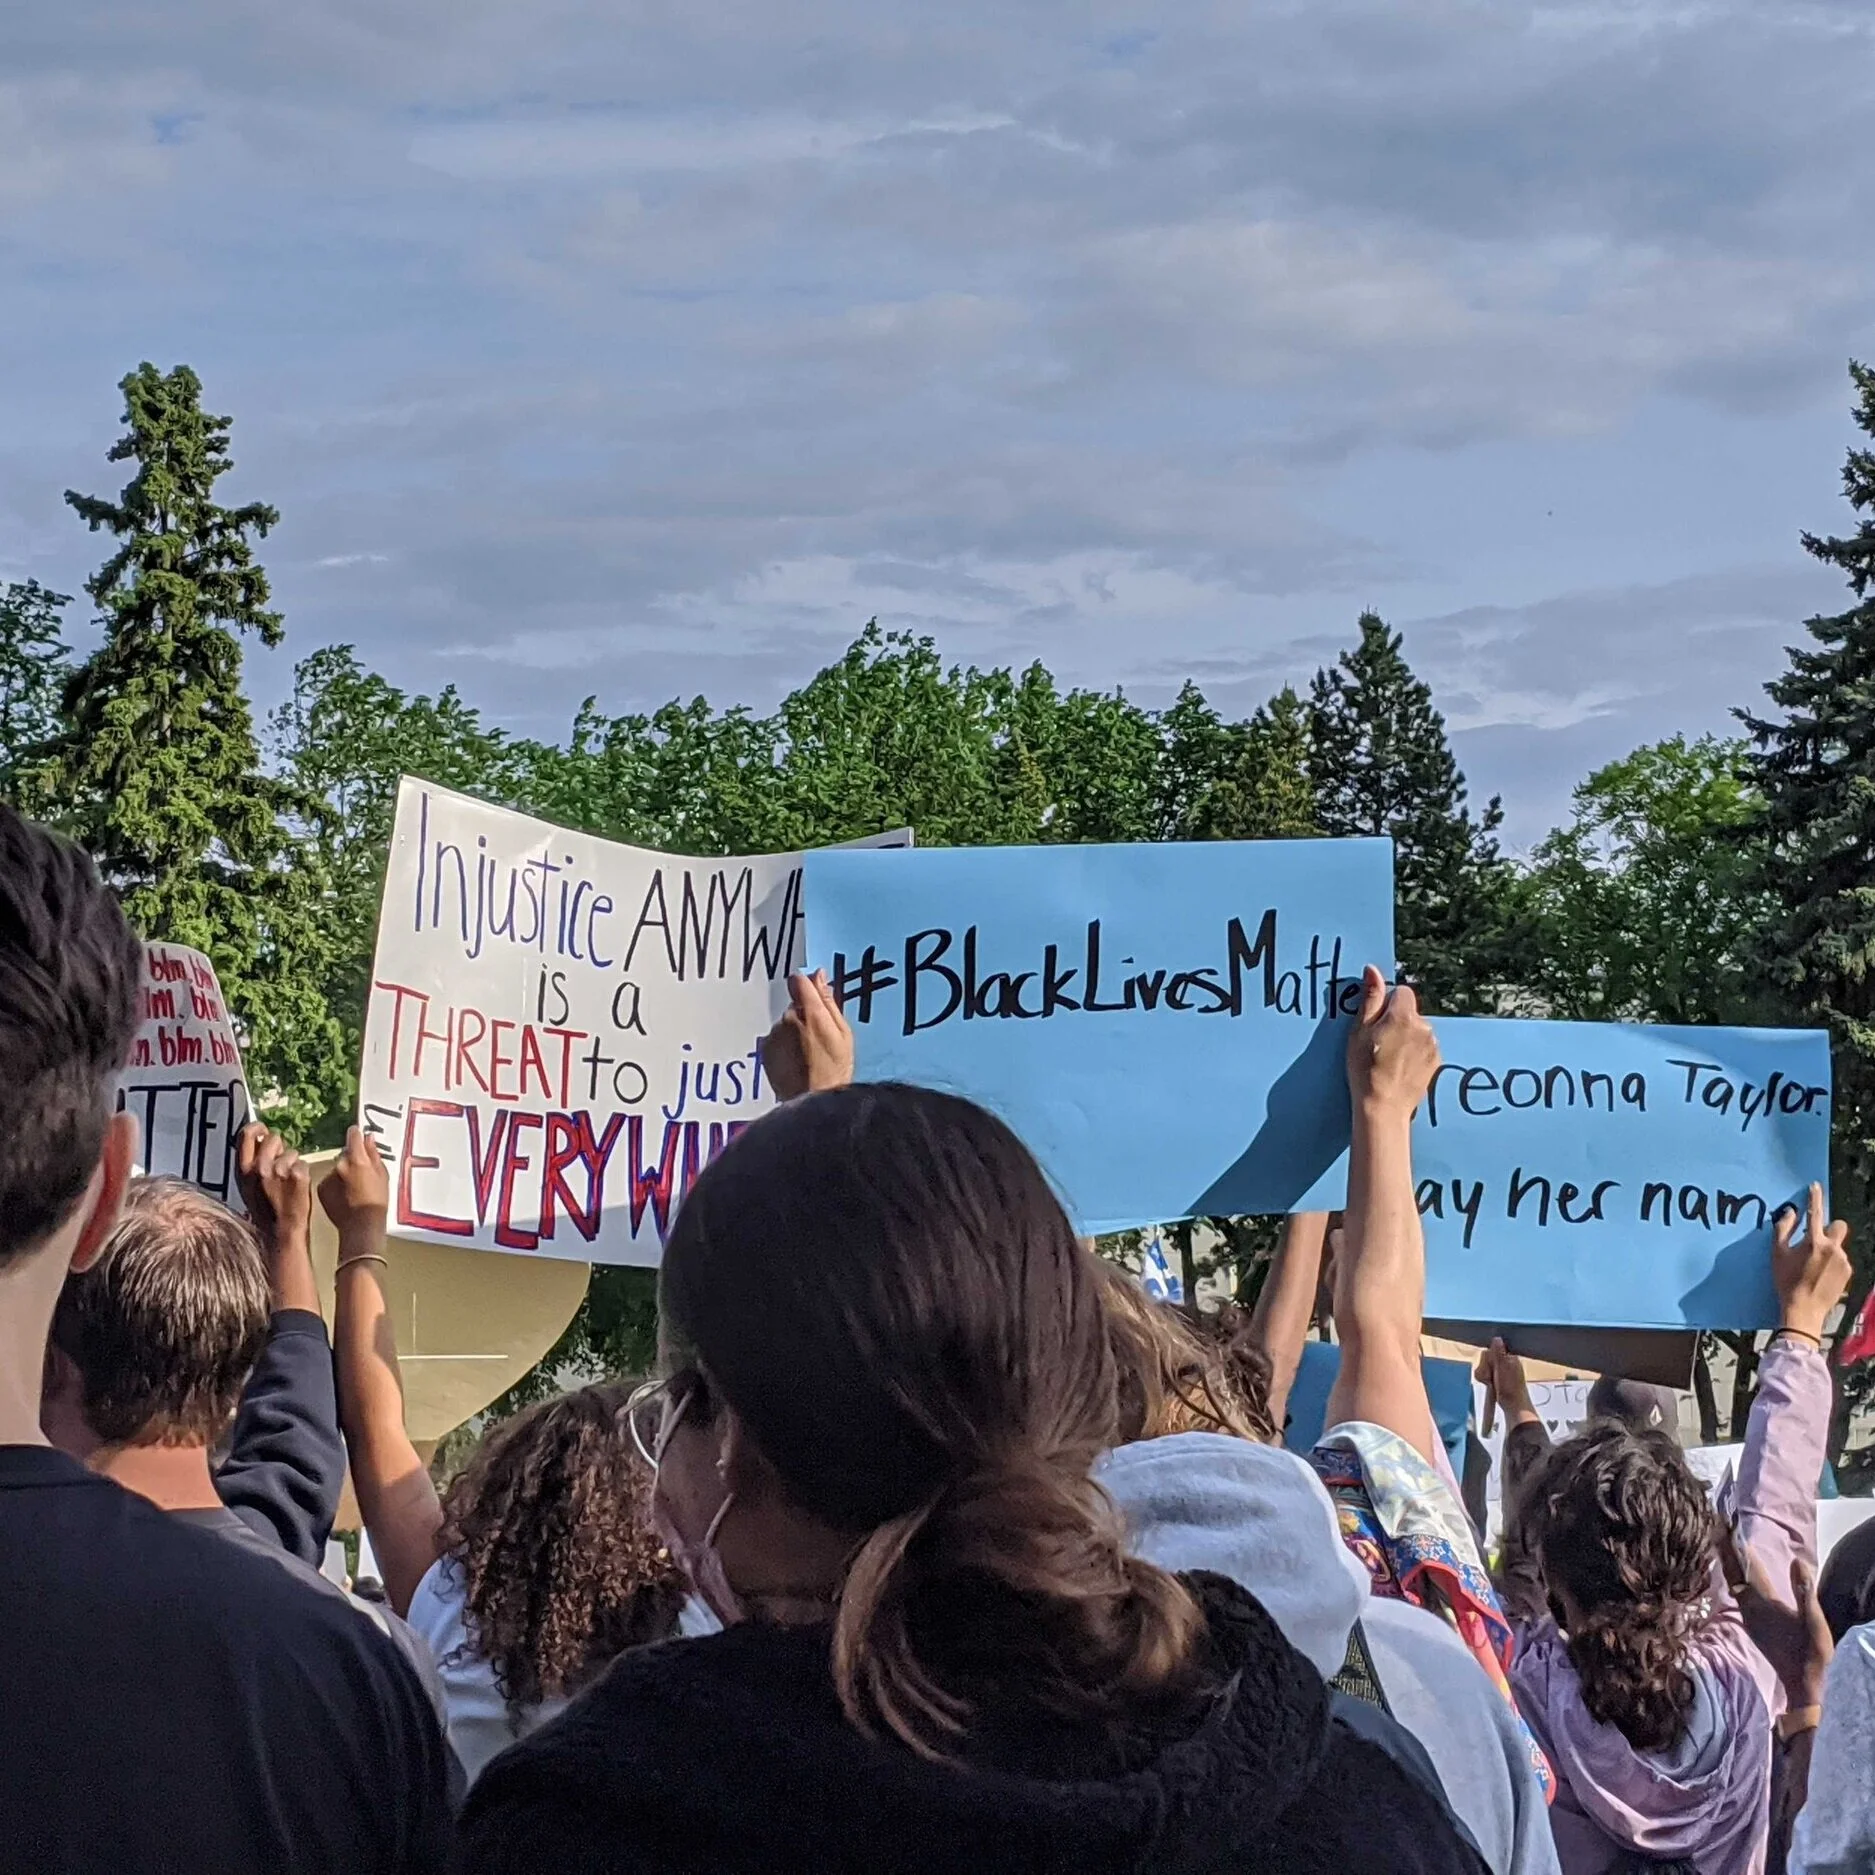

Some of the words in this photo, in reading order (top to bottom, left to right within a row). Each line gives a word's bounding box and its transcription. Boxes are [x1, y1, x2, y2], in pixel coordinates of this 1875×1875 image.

[414, 791, 614, 968] Injustice
[537, 962, 570, 1027] is
[611, 981, 647, 1037] a
[831, 908, 1394, 1037] #BlackLivesMatte
[375, 982, 588, 1110] THREAT
[582, 1036, 649, 1105] to
[1410, 1064, 1648, 1129] reonna
[1414, 1178, 1484, 1249] ay
[1507, 1166, 1621, 1227] her
